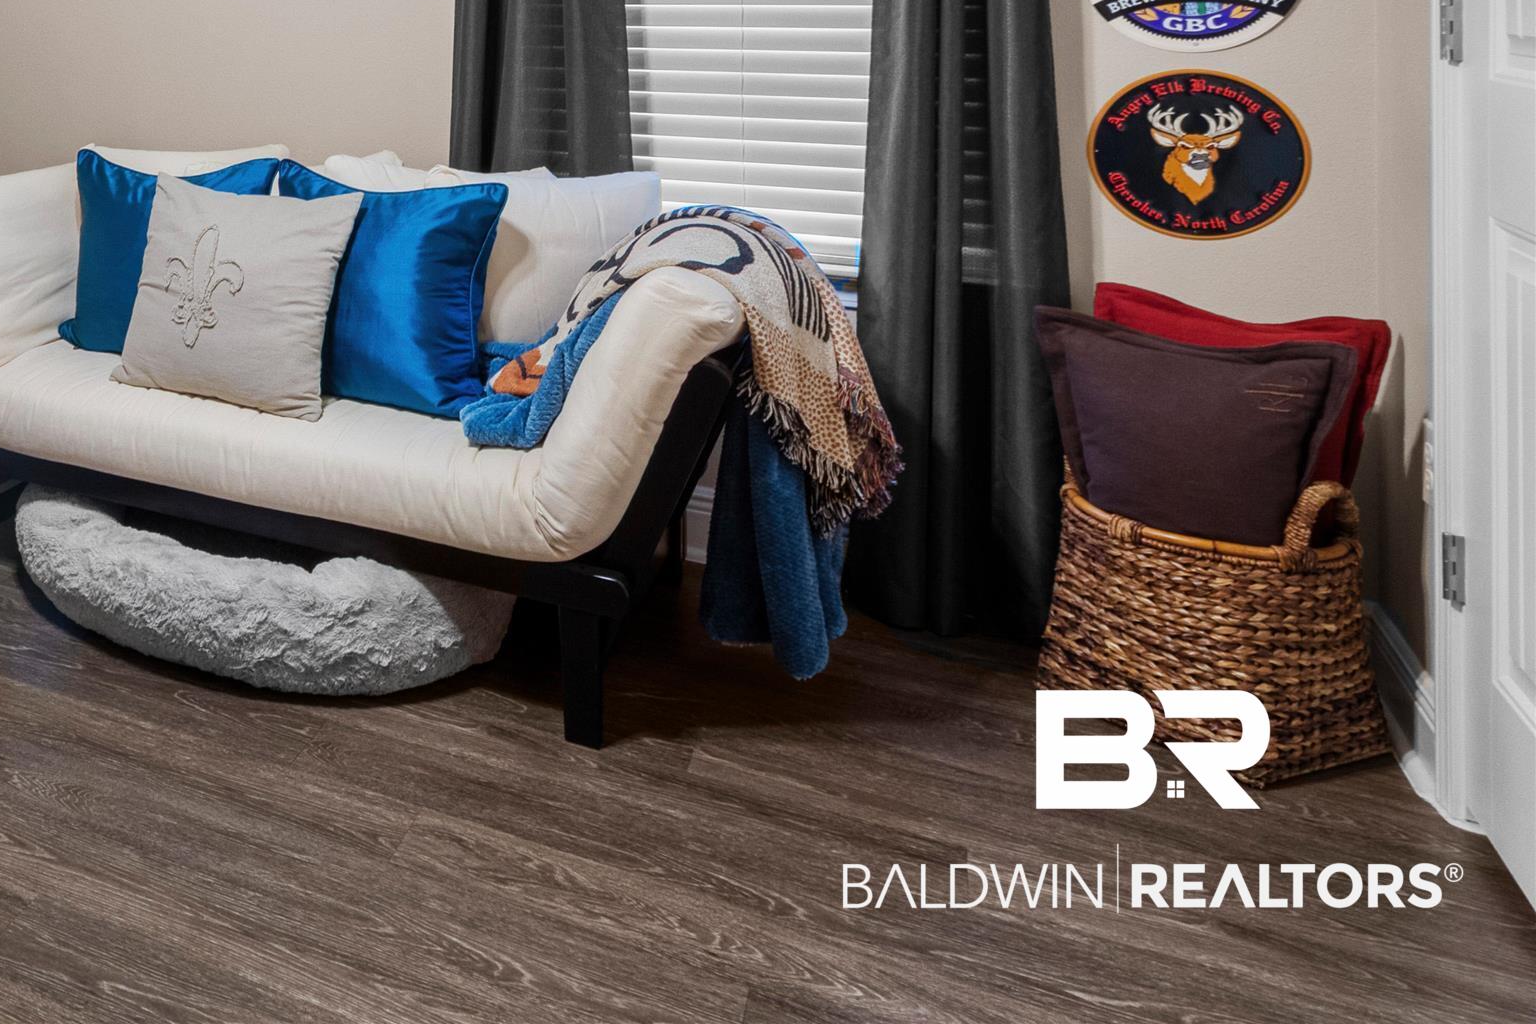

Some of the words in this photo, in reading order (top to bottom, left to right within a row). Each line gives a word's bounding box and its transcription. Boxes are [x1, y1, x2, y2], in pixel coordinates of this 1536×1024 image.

[1161, 12, 1230, 34] GBC
[1106, 92, 1154, 133] Angry
[1150, 79, 1185, 97] Elk
[1189, 77, 1263, 114] Brewing
[1261, 108, 1283, 136] Co.
[1108, 170, 1168, 224] Cherokee,
[1171, 211, 1229, 231] North
[1229, 179, 1291, 225] Carolina
